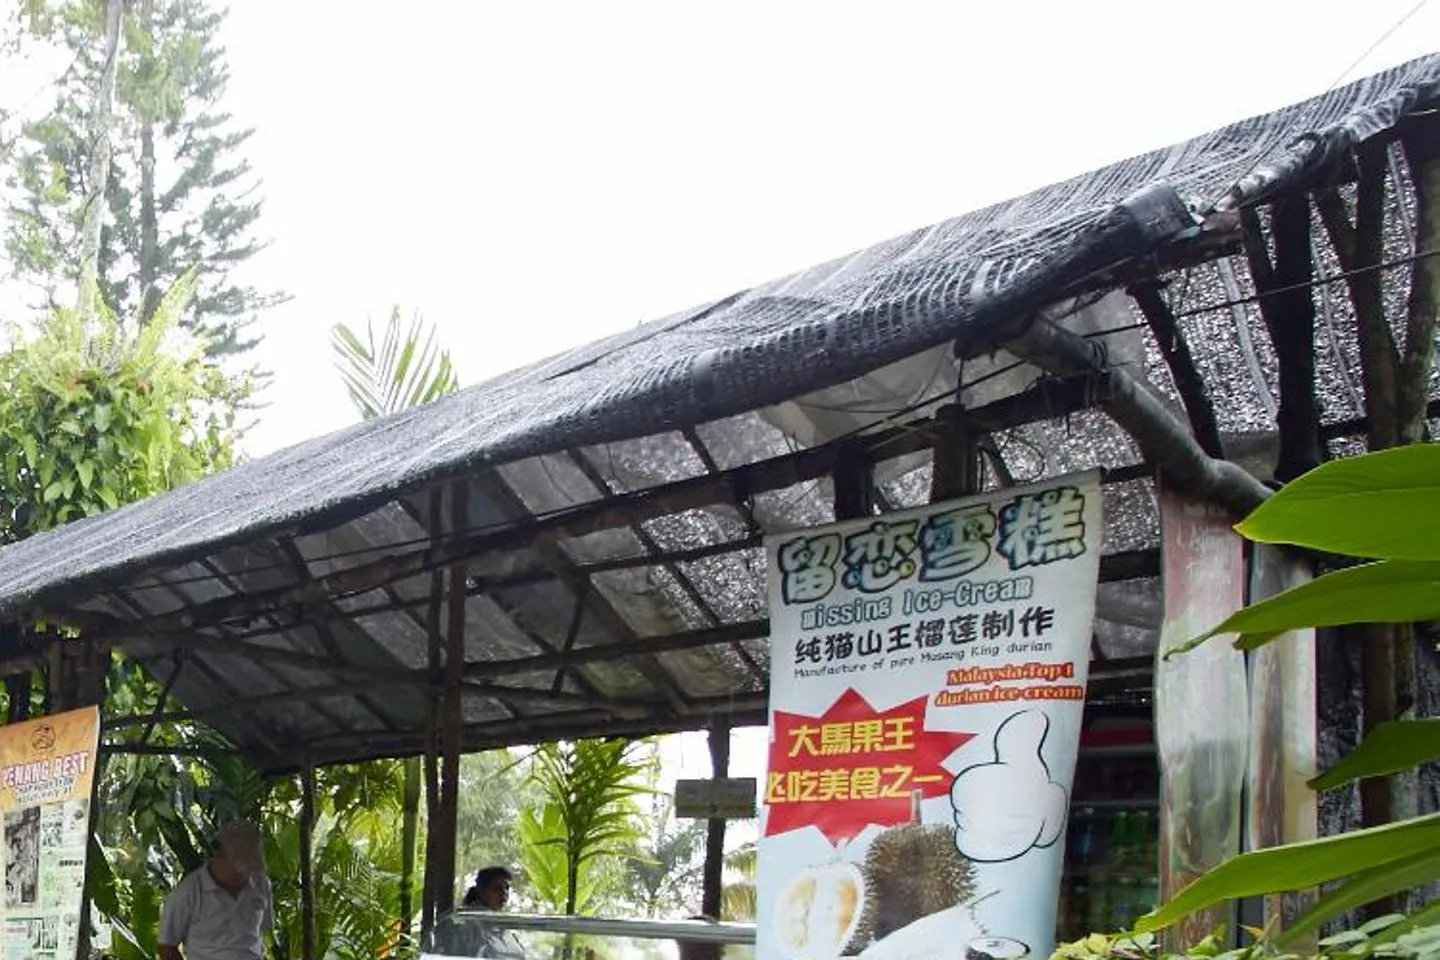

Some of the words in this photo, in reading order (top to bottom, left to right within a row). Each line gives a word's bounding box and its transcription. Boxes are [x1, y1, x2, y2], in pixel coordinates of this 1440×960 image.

[902, 575, 1034, 616] Ice-Cream
[793, 663, 867, 680] Manufacture
[872, 659, 884, 671] of
[890, 656, 915, 671] pure
[920, 650, 966, 664] Musang
[971, 645, 1000, 659] King
[1007, 641, 1053, 654] durian
